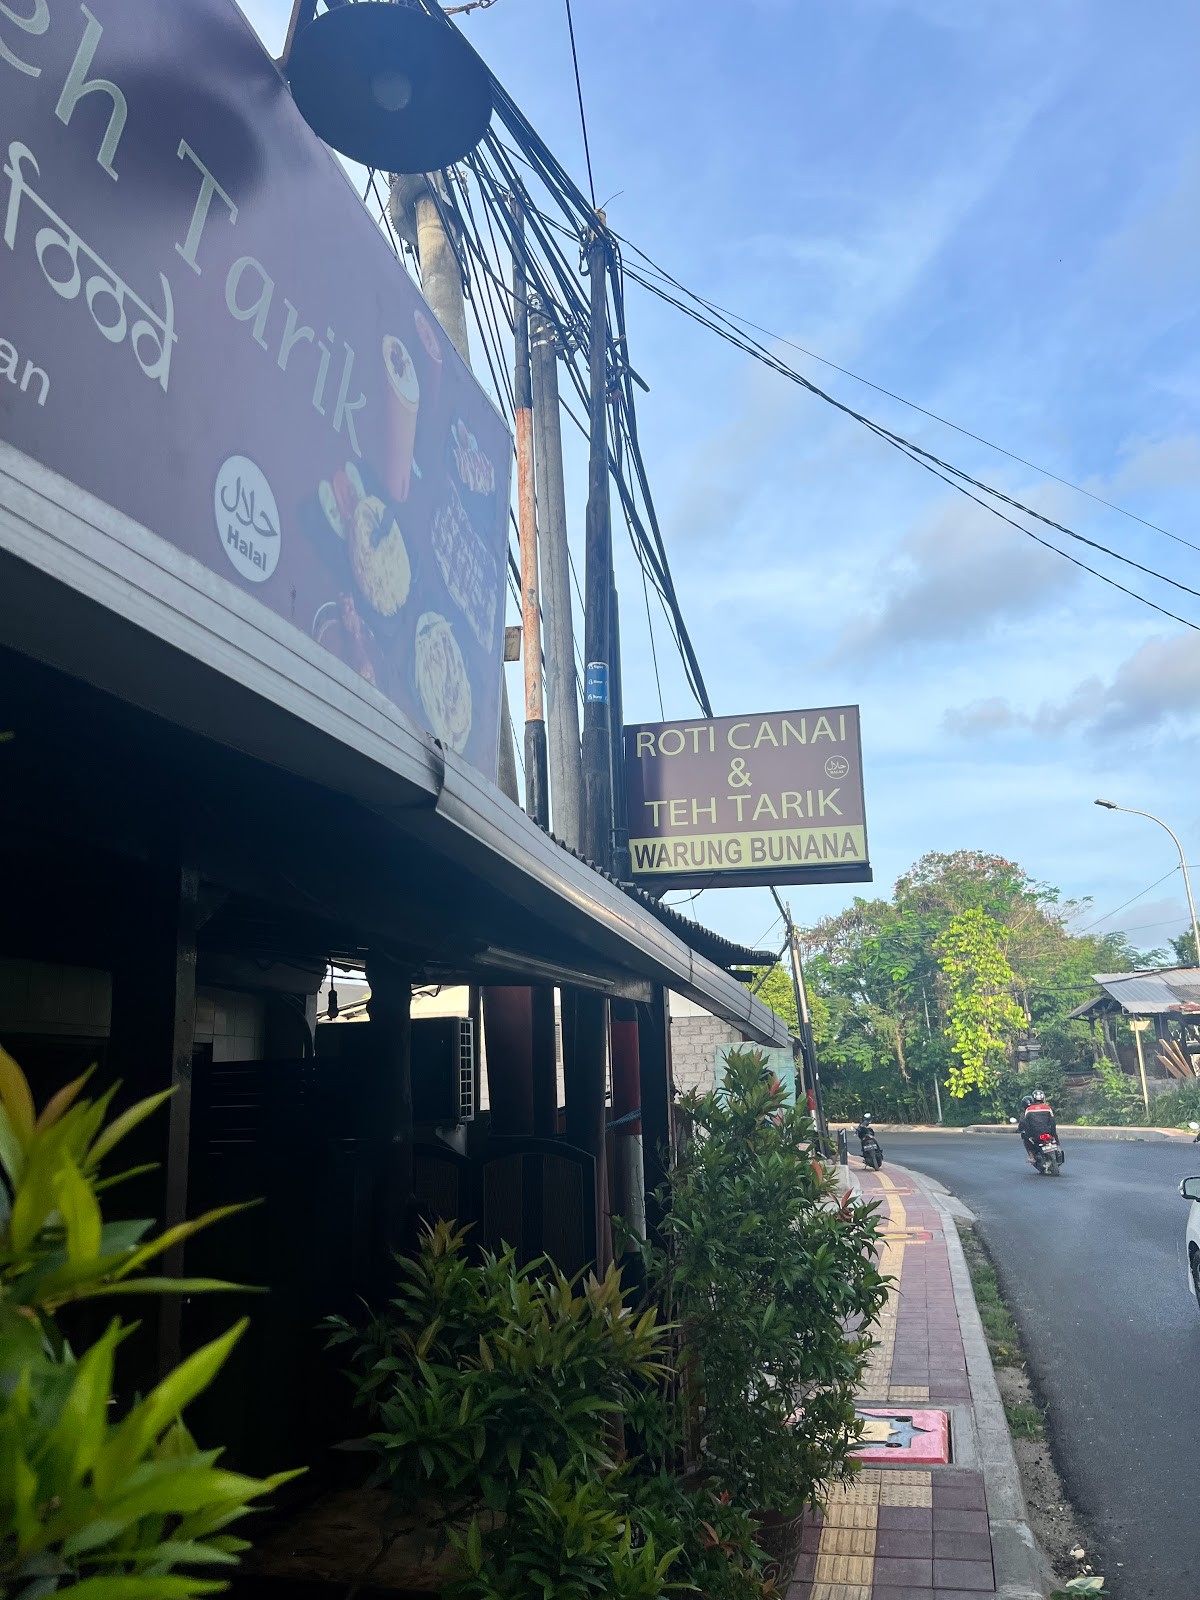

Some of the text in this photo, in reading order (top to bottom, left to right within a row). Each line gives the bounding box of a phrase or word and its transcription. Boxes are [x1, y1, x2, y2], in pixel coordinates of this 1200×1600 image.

[3, 141, 178, 393] food
[175, 139, 367, 458] Tarik
[220, 476, 278, 537] حلال
[227, 524, 267, 572] Halal
[636, 714, 846, 758] ROTI CANAI
[727, 757, 752, 788] &
[644, 787, 844, 828] TEH TARIK
[634, 832, 859, 869] WARUNG BUNANA
